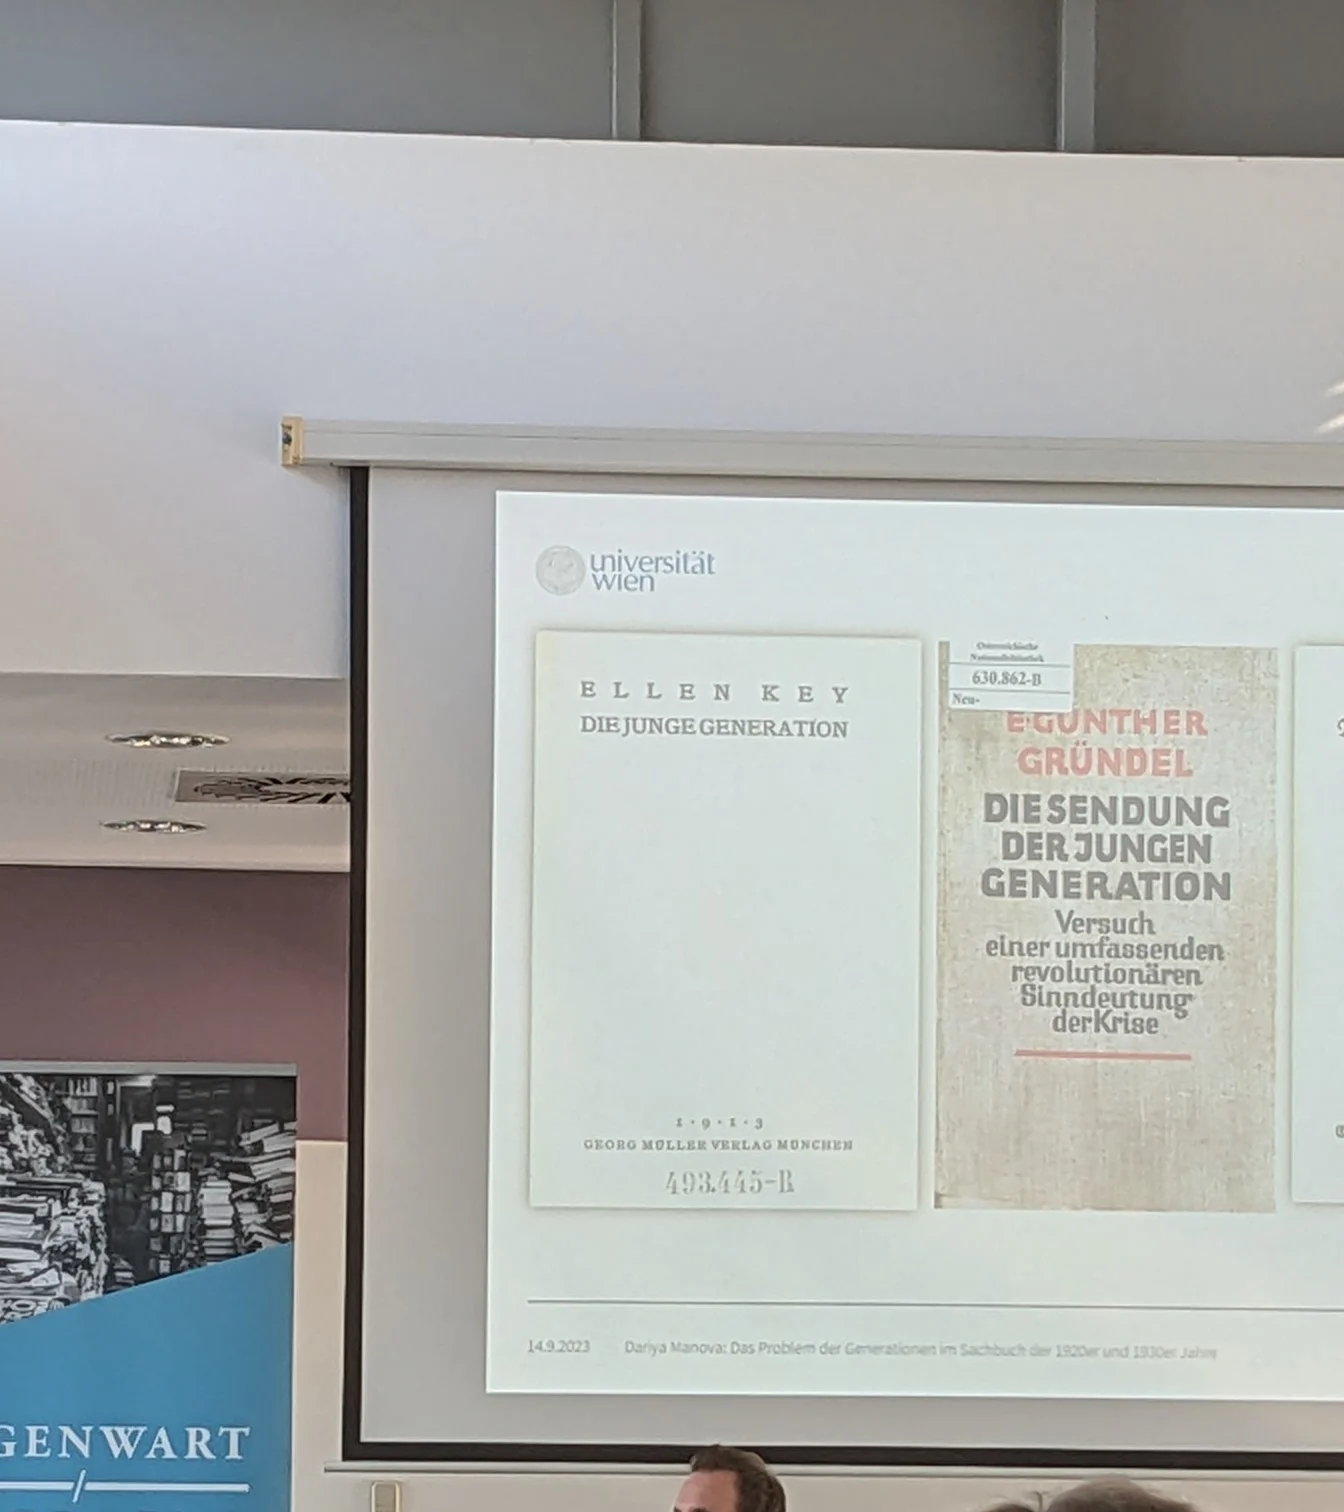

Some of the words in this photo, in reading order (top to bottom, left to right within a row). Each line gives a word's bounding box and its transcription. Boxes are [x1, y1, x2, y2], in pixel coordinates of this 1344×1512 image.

[590, 549, 716, 576] universität
[592, 573, 655, 592] wien
[971, 670, 1042, 687] 630.862-B
[580, 681, 732, 702] ELLEN
[761, 684, 849, 704] KEY
[580, 715, 620, 734] DIE
[621, 716, 697, 737] JUNGE
[699, 717, 849, 738] GENERATION
[1017, 739, 1194, 778] GRÜNDEL
[983, 792, 1041, 825] DIE
[1046, 793, 1230, 828] SENDUNG
[1001, 830, 1069, 862] DER
[1073, 832, 1213, 864] JUNGEN
[980, 867, 1232, 901] GENERATION
[1054, 908, 1157, 936] Versuch
[985, 935, 1050, 959] einer
[1055, 936, 1225, 961] umfassenden
[1010, 960, 1203, 986] revolutionären
[1019, 984, 1194, 1020] Sinndeutung
[1052, 1008, 1092, 1033] der
[1093, 1008, 1160, 1035] Krise
[583, 1138, 637, 1151] GEORG
[711, 1138, 773, 1151] VERLAG
[527, 1339, 591, 1354] 14.9.2023
[730, 1341, 756, 1355] Das
[758, 1341, 816, 1355] Problem
[819, 1342, 841, 1355] der
